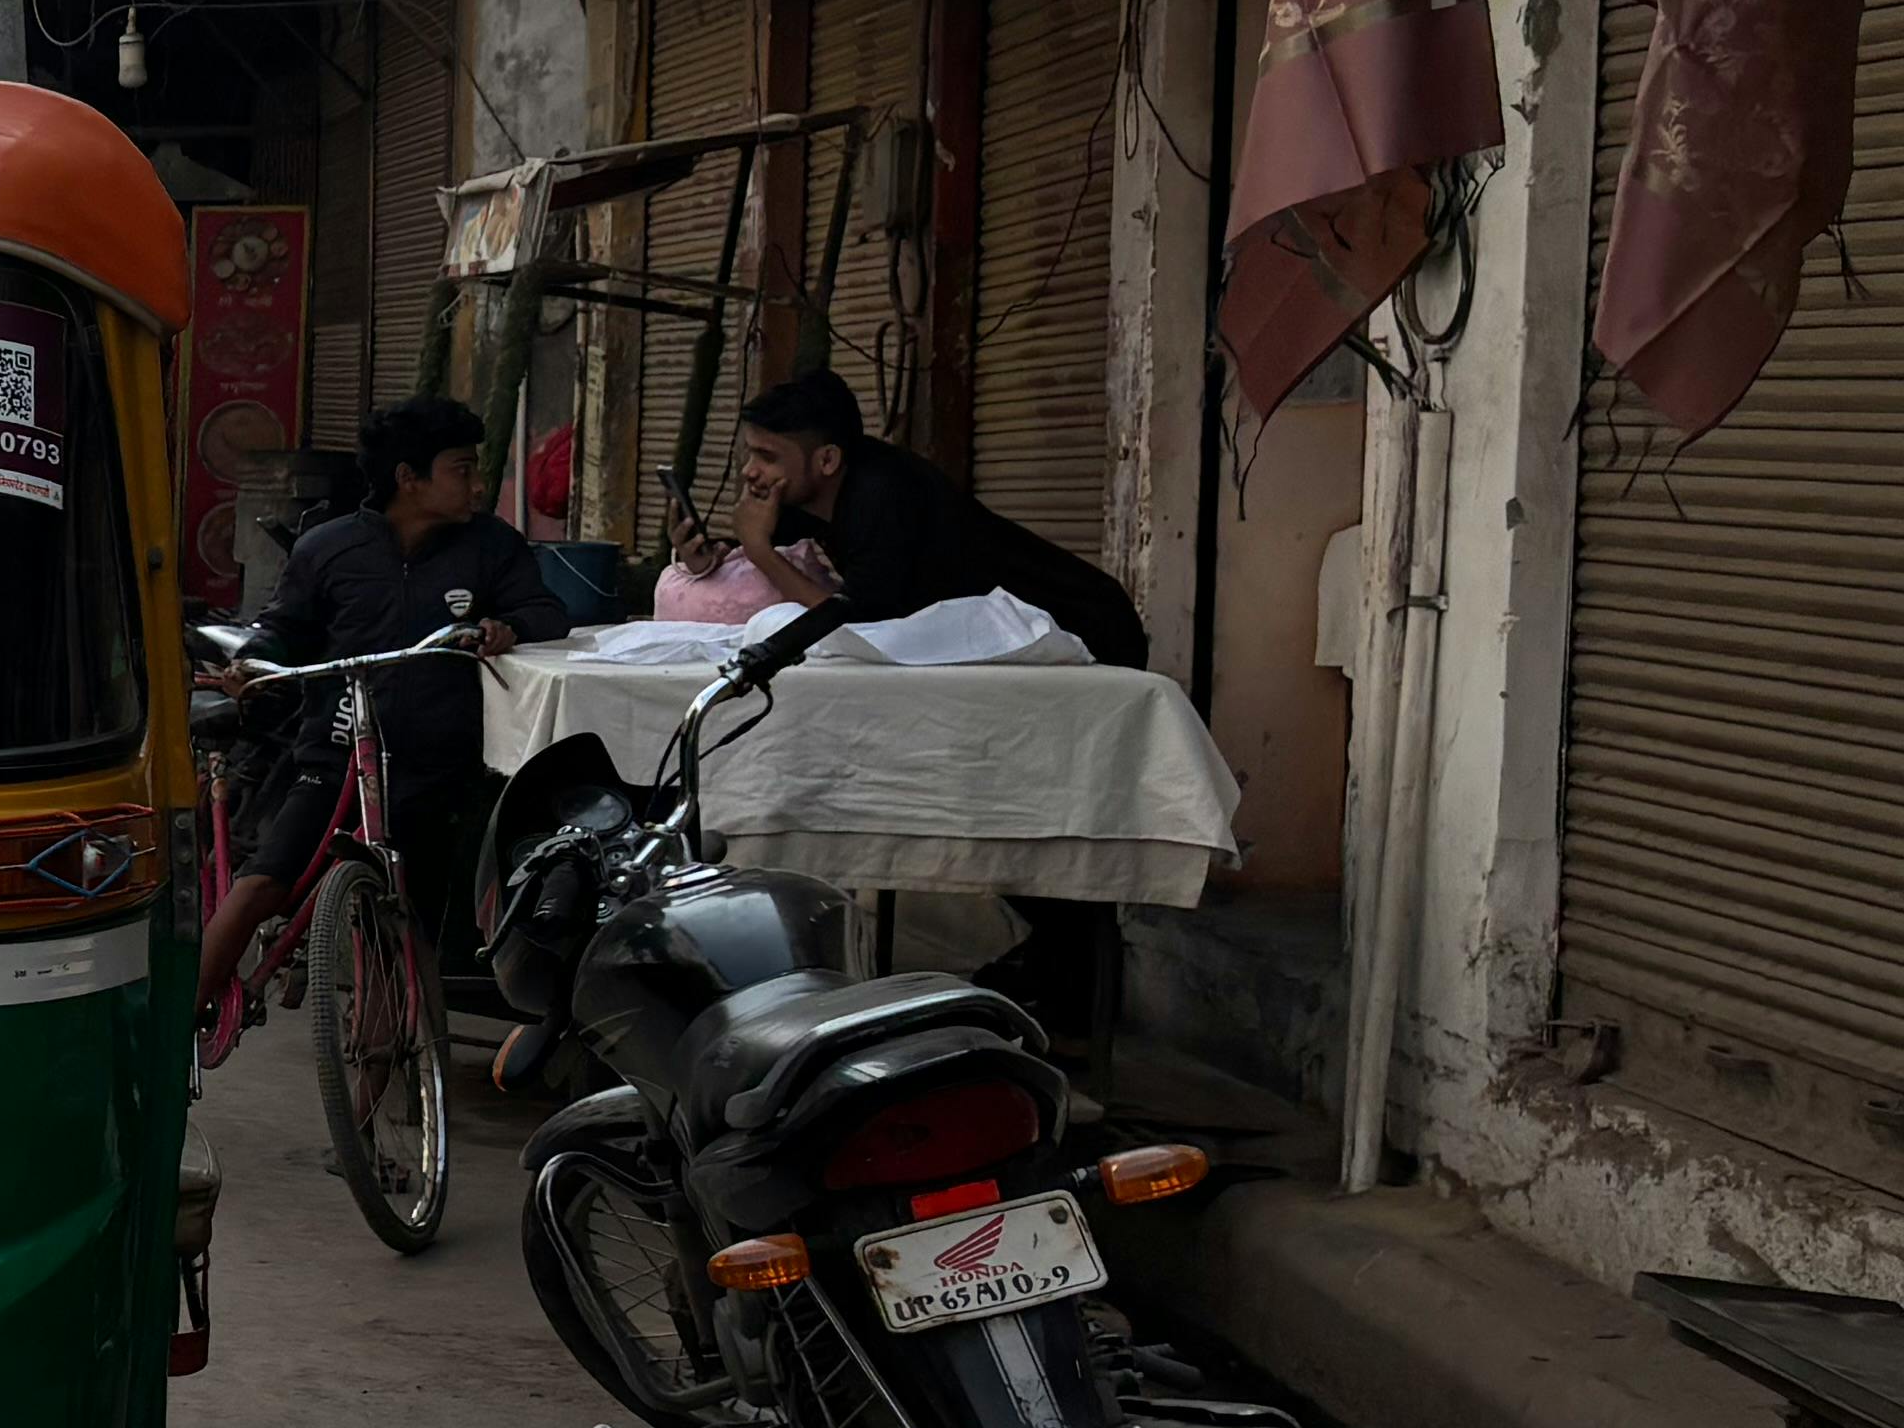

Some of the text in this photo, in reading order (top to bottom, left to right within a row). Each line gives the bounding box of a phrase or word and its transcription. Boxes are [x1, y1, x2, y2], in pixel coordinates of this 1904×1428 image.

[0, 431, 60, 465] 0793
[940, 1262, 1024, 1287] HONDA
[894, 1295, 934, 1321] UP
[940, 1286, 971, 1309] 65
